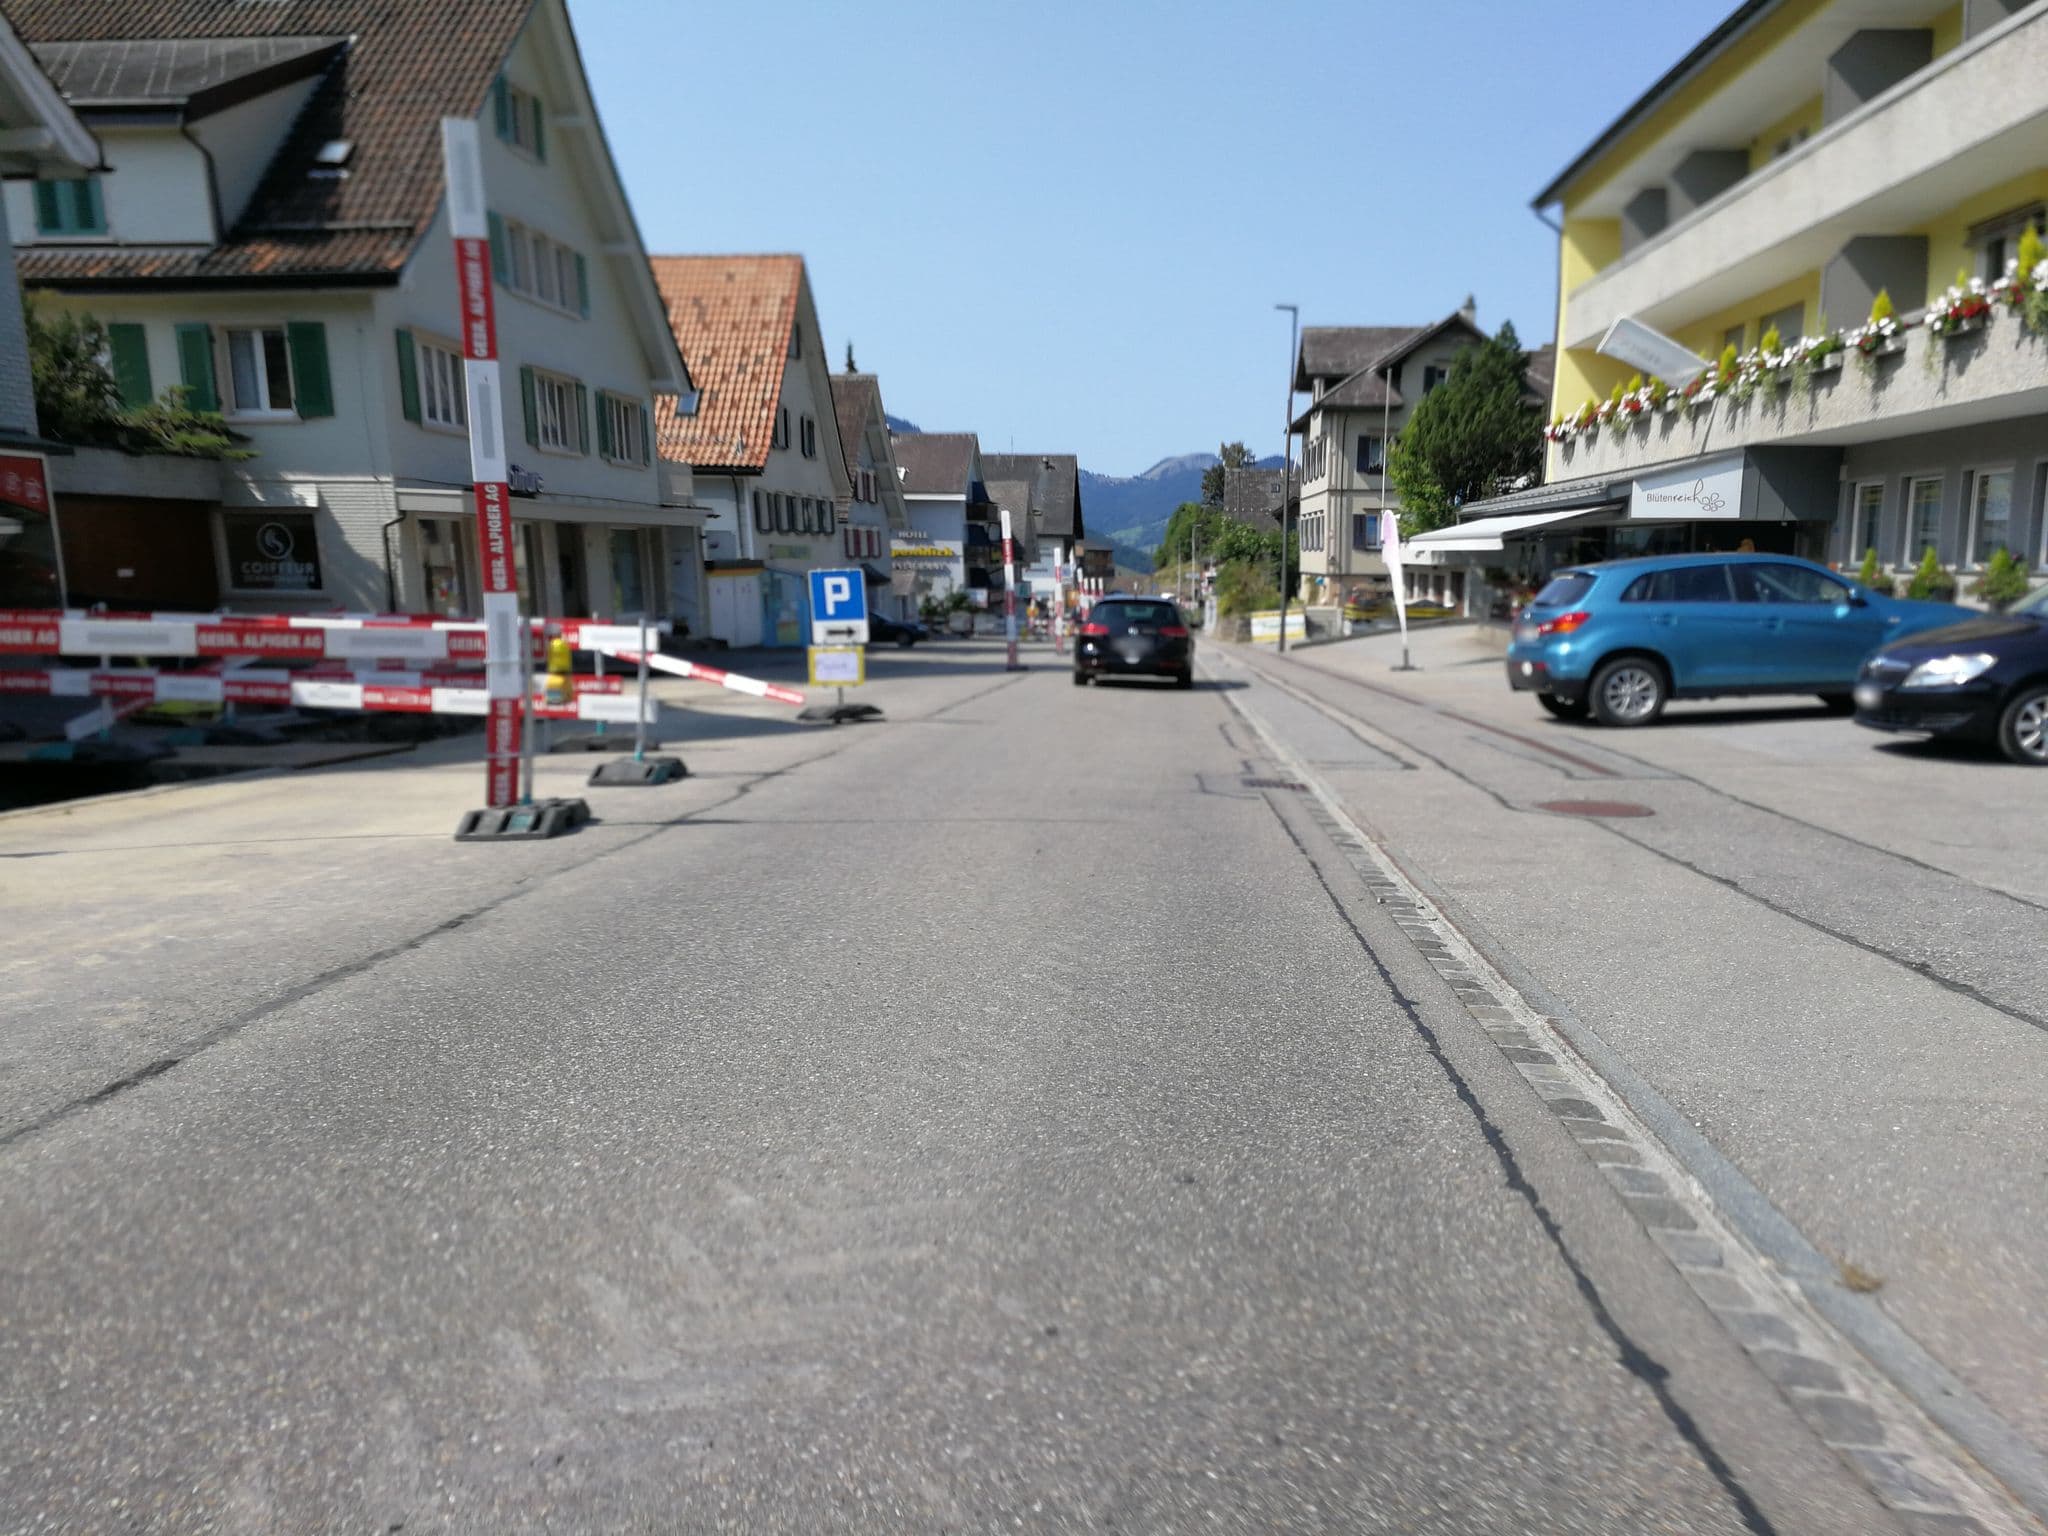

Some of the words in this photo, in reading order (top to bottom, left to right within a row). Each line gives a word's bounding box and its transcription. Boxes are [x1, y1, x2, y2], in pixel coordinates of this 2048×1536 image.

[484, 484, 499, 501] AG
[1646, 479, 1702, 504] Blütenreich
[487, 503, 505, 554] ALPIGER
[241, 561, 315, 574] COIFFEUR
[823, 576, 850, 616] P
